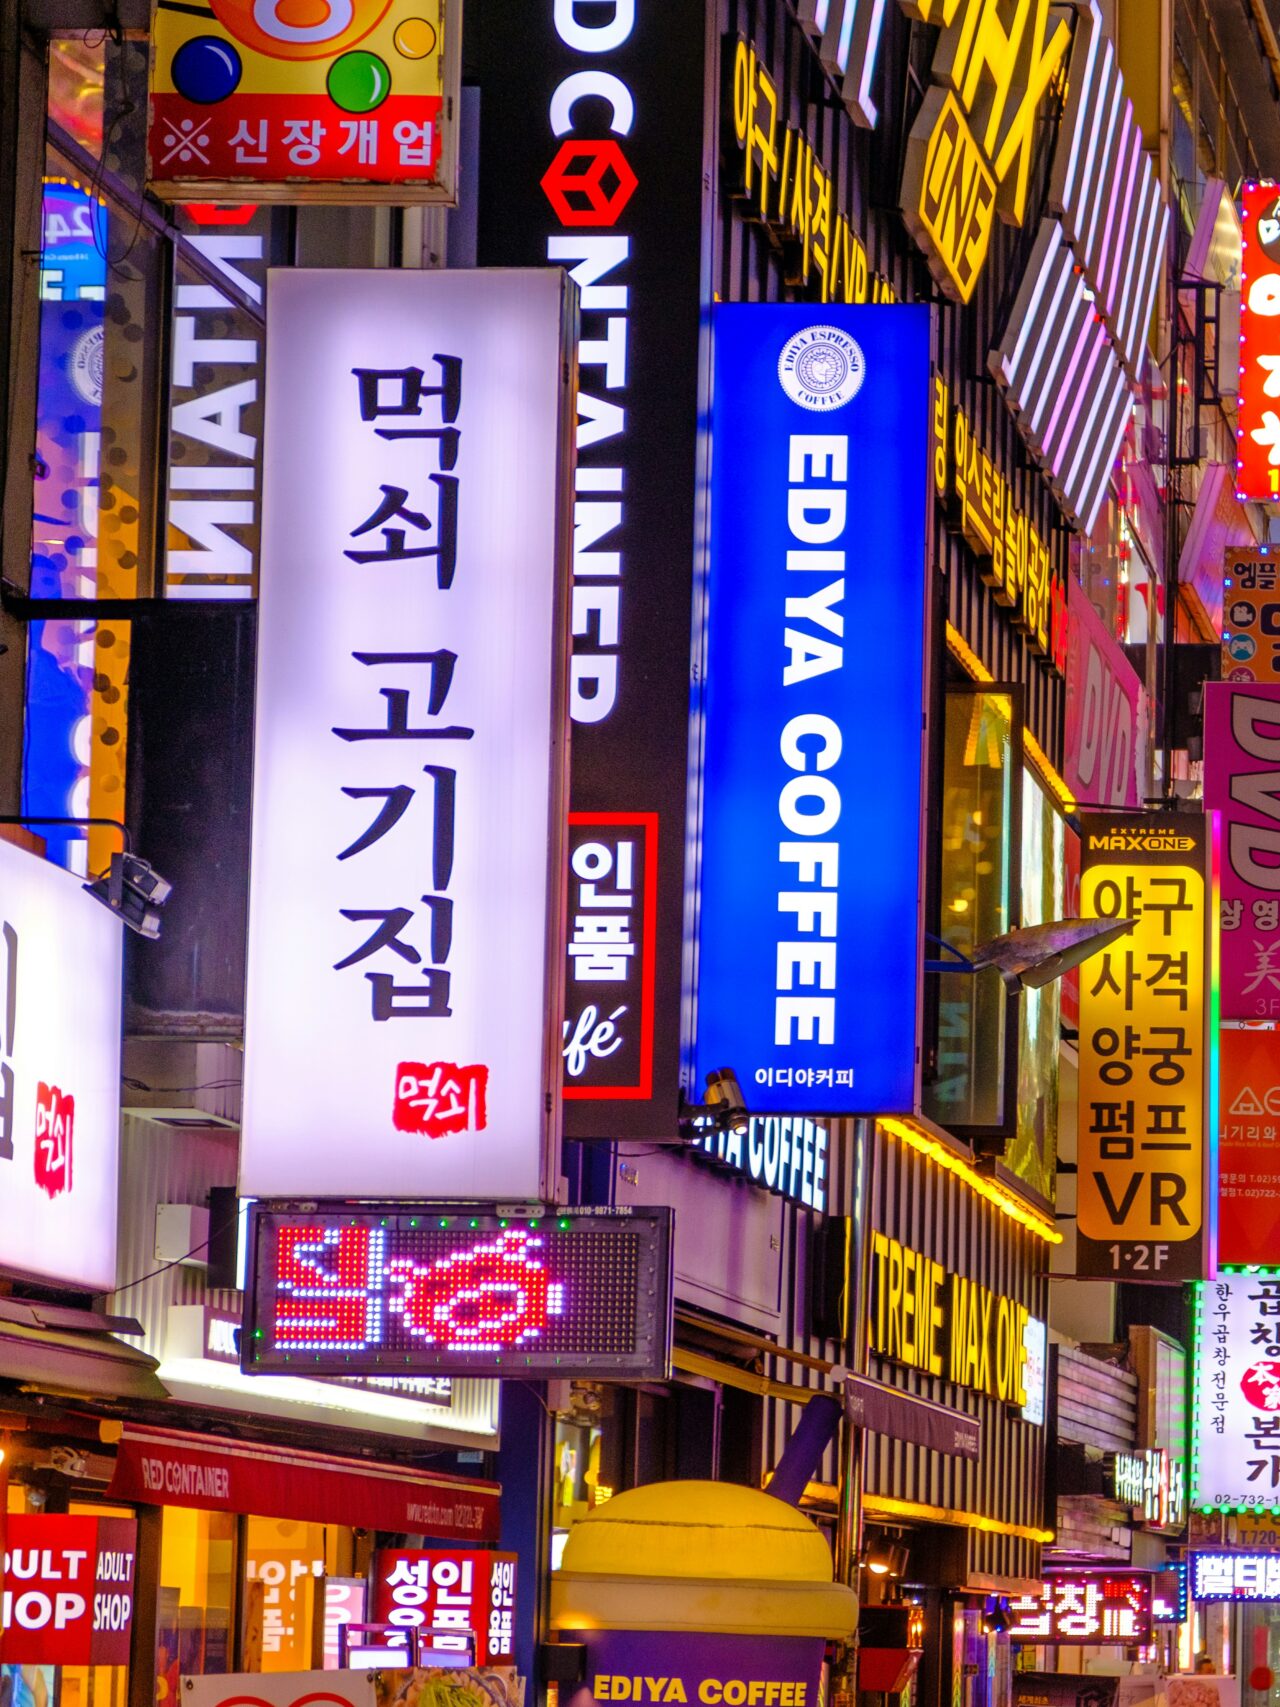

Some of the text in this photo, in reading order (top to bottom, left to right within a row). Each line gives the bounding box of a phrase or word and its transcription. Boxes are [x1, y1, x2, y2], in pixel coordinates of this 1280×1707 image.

[227, 117, 434, 166] 신장개업
[784, 331, 860, 373] EDIYA ESPRESSO
[331, 354, 475, 1021] 먹쇠 고기집
[775, 434, 848, 1046] EDIYA COFFEE
[1093, 877, 1193, 937] 야구
[1090, 951, 1189, 1011] 사격
[1255, 998, 1280, 1016] 3F
[755, 1067, 854, 1088] 이디야커피
[1092, 1026, 1192, 1087] 양궁
[1089, 1101, 1191, 1160] 펌프
[749, 1117, 828, 1213] COFFEE
[1092, 1171, 1190, 1227] VR
[951, 1272, 994, 1394] MAX
[998, 1294, 1029, 1408] ONE
[142, 1458, 162, 1488] RED
[96, 1551, 133, 1581] ADULT
[386, 1560, 453, 1607] 성인
[490, 1562, 514, 1602] 성인
[93, 1593, 131, 1631] SHOP
[593, 1674, 808, 1706] EDIYA COFFEE
